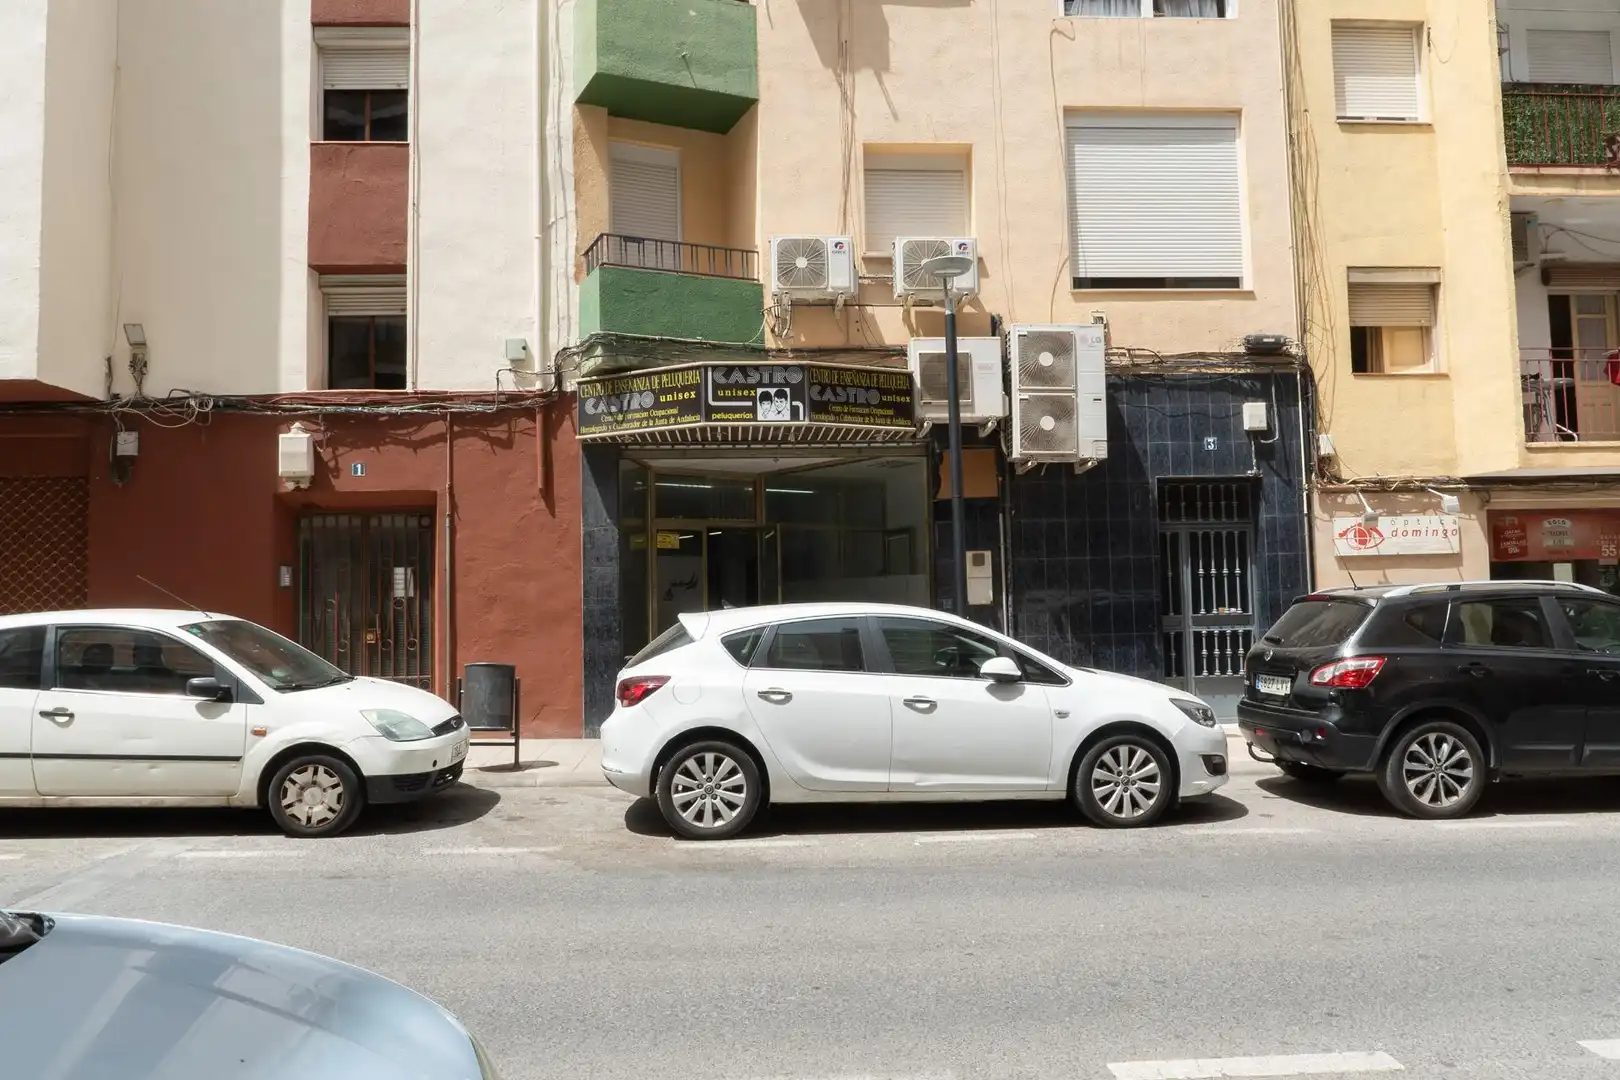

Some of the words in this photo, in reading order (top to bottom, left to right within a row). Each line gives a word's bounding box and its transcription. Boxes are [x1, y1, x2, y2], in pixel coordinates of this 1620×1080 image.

[713, 367, 803, 384] CASTRO
[580, 382, 604, 398] CENTRO
[604, 380, 614, 395] DE
[717, 388, 756, 396] unisex
[809, 384, 881, 405] CASTRO
[881, 394, 911, 403] unisex
[584, 391, 655, 415] CASTRO
[659, 390, 697, 402] unisex
[1208, 440, 1214, 449] 3
[1391, 528, 1458, 539] domingo
[1601, 544, 1617, 557] 55
